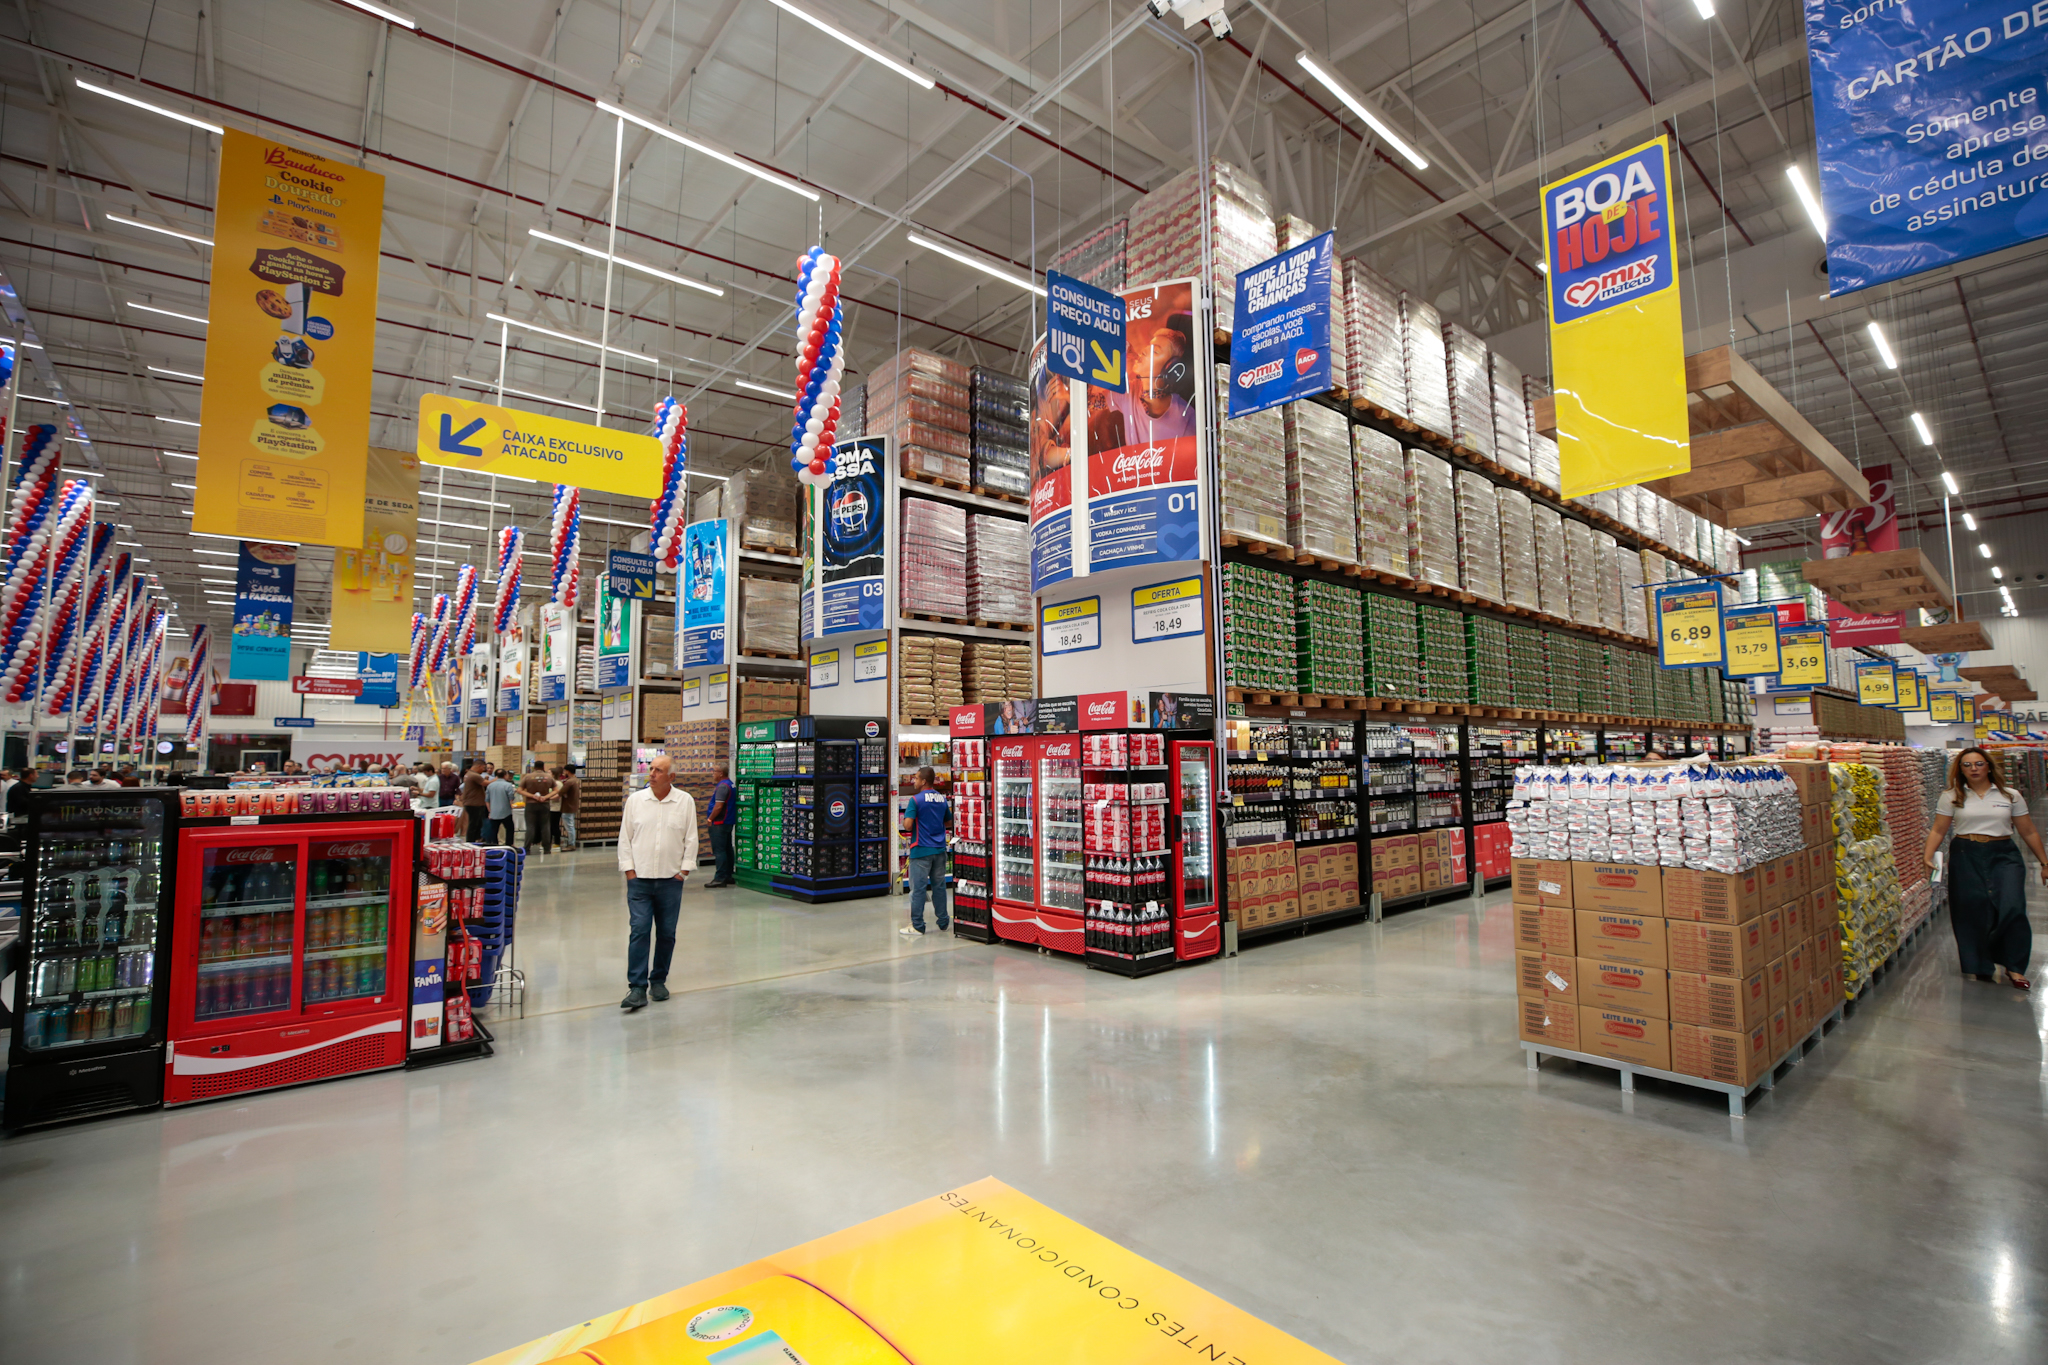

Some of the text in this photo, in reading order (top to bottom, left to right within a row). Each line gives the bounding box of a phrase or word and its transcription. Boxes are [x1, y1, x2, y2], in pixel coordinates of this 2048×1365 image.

[1847, 26, 1992, 100] CARTÃO
[1906, 87, 2037, 144] Somente
[287, 147, 326, 162] PROMOÇÃO
[264, 147, 345, 182] Bauducco
[280, 170, 334, 194] Cookie
[1869, 144, 2048, 215] de cédula de
[264, 175, 342, 207] Dourado
[1555, 161, 1656, 230] BOA
[287, 200, 336, 219] PlayStation
[1907, 172, 2048, 232] assinatura
[1607, 204, 1621, 220] DE
[1557, 192, 1661, 274] HOJE
[268, 254, 330, 274] Cookie Dourado
[286, 253, 307, 263] Ache
[266, 260, 292, 272] ganhe
[305, 269, 324, 279] hora
[1244, 246, 1317, 291] MUDE A VIDA
[1602, 257, 1657, 289] mix
[258, 264, 331, 290] PlayStation 5
[1248, 263, 1310, 301] DE MUITAS
[1602, 274, 1652, 298] mateus
[1052, 284, 1121, 321] CONSULTE O
[1129, 296, 1153, 308] SEUS
[1248, 278, 1307, 314] CRIANÇAS
[1052, 300, 1120, 337] PREÇO AQUI
[1241, 302, 1317, 339] Comprando nossas
[1251, 316, 1304, 343] sacolas, você
[1251, 326, 1305, 354] ajuda a AACD.
[1256, 358, 1284, 375] mix
[1298, 353, 1317, 365] AACD
[273, 373, 310, 384] milhares
[1256, 370, 1282, 383] mateus
[280, 379, 314, 390] prêmios
[257, 436, 317, 451] PlayStation
[503, 429, 624, 461] CAIXA EXCLUSIVO
[501, 443, 568, 465] ATACADO
[836, 448, 874, 466] OMA
[391, 501, 414, 510] SEDA
[841, 503, 866, 514] PEPSI
[1167, 491, 1196, 513] 01
[1104, 508, 1124, 518] WHISKY
[1095, 524, 1146, 537] VODKA CONHAQUE
[1099, 546, 1123, 556] CACHAÇA
[612, 555, 648, 567] CONSULTE
[612, 563, 653, 575] PREÇO AQUI
[240, 592, 247, 600] E
[251, 584, 281, 593] SABOR
[863, 582, 884, 597] 03
[1151, 587, 1181, 600] OFERTA
[1059, 606, 1082, 618] OFERTA
[1155, 617, 1182, 632] 18,49
[1837, 616, 1897, 628] Budweiser
[710, 629, 724, 640] 05
[1060, 634, 1083, 647] 18,49
[1735, 643, 1768, 655] 13,79
[618, 657, 629, 666] 07
[1787, 656, 1818, 669] 3,69
[555, 676, 565, 684] 09
[1864, 683, 1889, 694] 4,99
[1088, 701, 1116, 716] Coca-Cola
[1290, 710, 1307, 718] WHISKY
[956, 712, 976, 725] Coca-Cola
[1001, 745, 1024, 758] Coca-Cola
[1046, 743, 1071, 756] Coca-Cola
[348, 753, 404, 769] mix
[80, 805, 151, 816] MONSTER
[226, 847, 275, 863] Coca-Cola
[327, 842, 372, 857] Coca-Cola
[1632, 918, 1643, 926] PÓ
[1599, 964, 1617, 972] LEITE
[1633, 968, 1644, 976] PÓ
[414, 974, 442, 988] FANTA
[1602, 1013, 1620, 1021] LEITE
[1636, 1017, 1647, 1026] PÓ
[940, 1192, 1139, 1310] CONDICIONANTES
[718, 1306, 744, 1314] MACIO
[689, 1316, 702, 1333] MACIO
[734, 1312, 750, 1332] TOQUE
[692, 1332, 721, 1340] TOQUE
